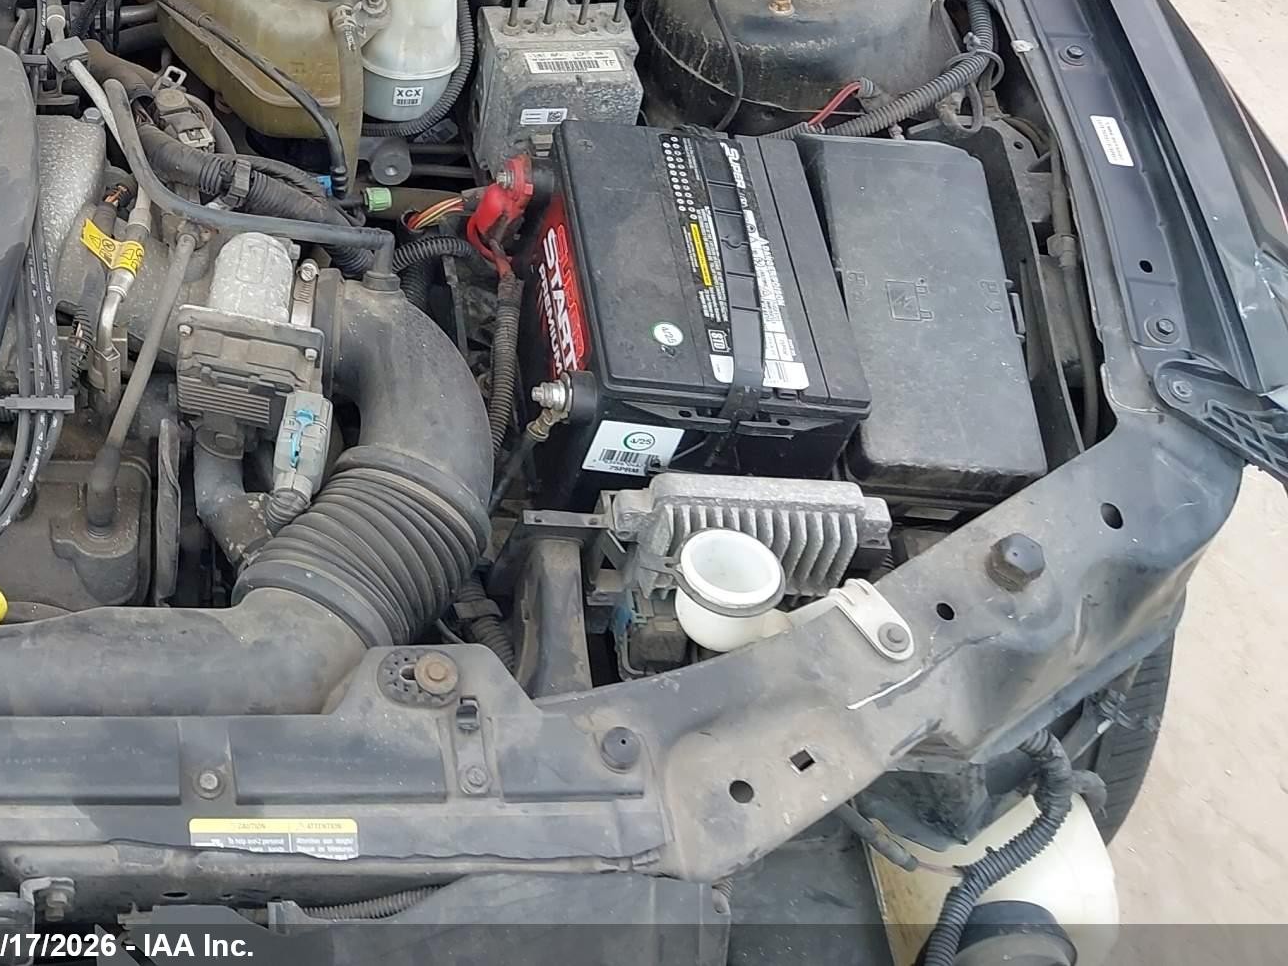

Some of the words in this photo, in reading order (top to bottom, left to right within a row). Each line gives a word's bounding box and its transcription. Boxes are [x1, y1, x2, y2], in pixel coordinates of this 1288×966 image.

[396, 88, 422, 98] XCX
[726, 147, 746, 189] SUPER
[538, 262, 563, 375] PREMIUM
[543, 227, 578, 371] START
[557, 224, 584, 358] SUPER
[306, 822, 342, 830] ATTENTION
